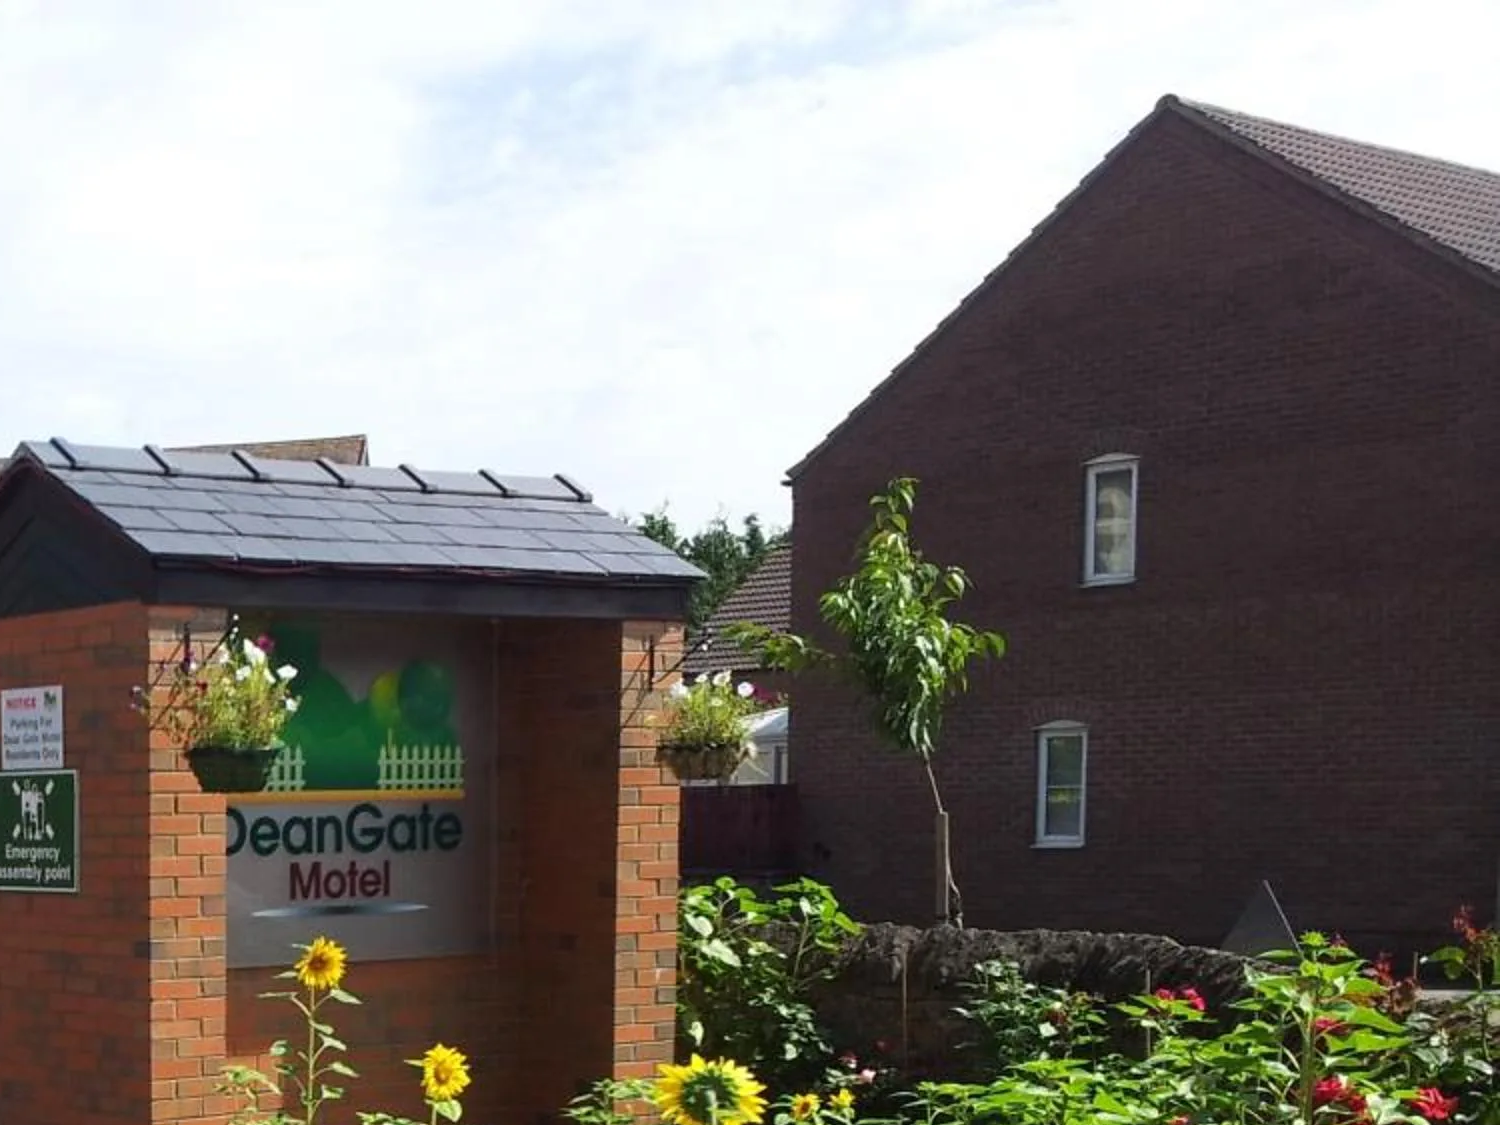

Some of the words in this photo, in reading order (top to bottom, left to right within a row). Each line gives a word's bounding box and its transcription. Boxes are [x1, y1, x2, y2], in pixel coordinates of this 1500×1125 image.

[226, 802, 463, 857] DeanGate
[5, 843, 60, 863] Emergency
[44, 865, 71, 883] point
[289, 859, 391, 900] Motel
